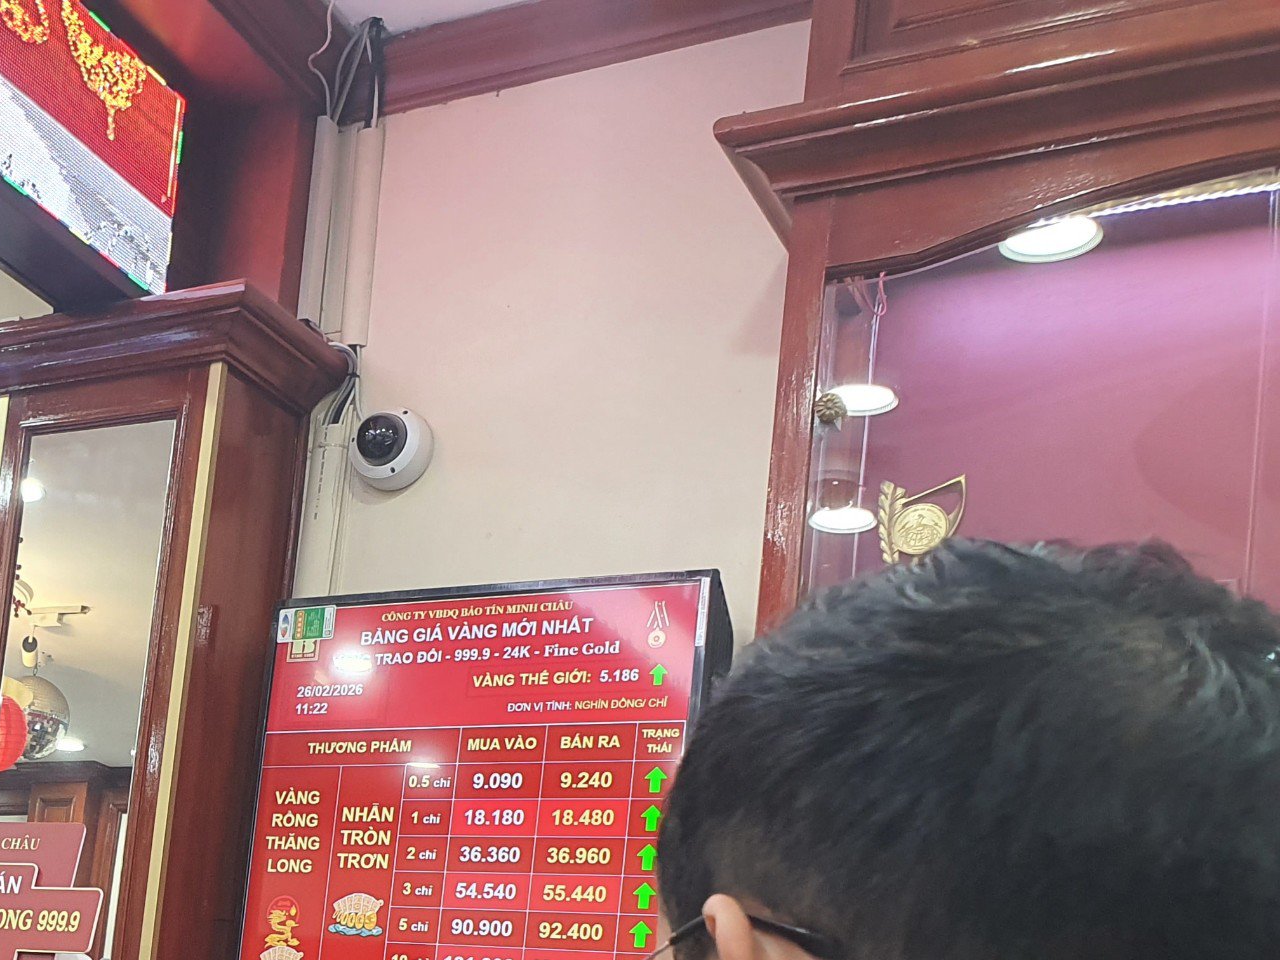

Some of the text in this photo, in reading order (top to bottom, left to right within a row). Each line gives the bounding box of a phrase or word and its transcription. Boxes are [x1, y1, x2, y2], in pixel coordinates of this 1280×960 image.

[382, 600, 573, 622] CÔNG TY VBDQ BẢO TÍN MINH CHÂU
[361, 617, 594, 645] BẢNG GIÁ VÀNG MỚI NHẤT
[375, 653, 412, 665] TRAO
[417, 649, 442, 664] ĐỔI
[454, 648, 490, 662] 999.9
[503, 646, 530, 659] 24K
[544, 645, 578, 657] Fine
[582, 641, 620, 656] Gold
[473, 669, 639, 688] VÀNG THẾ GIỚI: 5.186
[297, 684, 364, 698] 26/02/2026
[296, 703, 328, 715] 11:22
[507, 702, 533, 712] ĐƠN
[534, 702, 543, 712] VỊ
[546, 700, 572, 711] TÍNH:
[575, 699, 609, 710] NGHÌN
[648, 696, 668, 708] CHỈ
[308, 728, 680, 755] THƯƠNG PHẨM MUA VÀO BÁN RA TRẠNG
[647, 743, 672, 753] THÁI
[408, 772, 613, 789] 0.5 chỉ 9.090 9.240
[275, 787, 320, 805] VÀNG
[272, 811, 318, 828] RỒNG
[342, 803, 394, 823] NHẪN
[411, 809, 614, 825] 1 chỉ 18.180 18.480
[1, 833, 40, 851] CHÂU
[266, 833, 320, 850] THĂNG
[341, 827, 391, 846] TRÒN
[337, 852, 389, 870] TRƠN
[406, 846, 611, 864] 2 chỉ 36.360 36.960
[267, 859, 312, 873] LONG
[402, 882, 607, 902] 3 chỉ 54.540 55.440
[36, 910, 81, 932] 999.9
[399, 918, 603, 941] 5 chỉ 90.900 92.400
